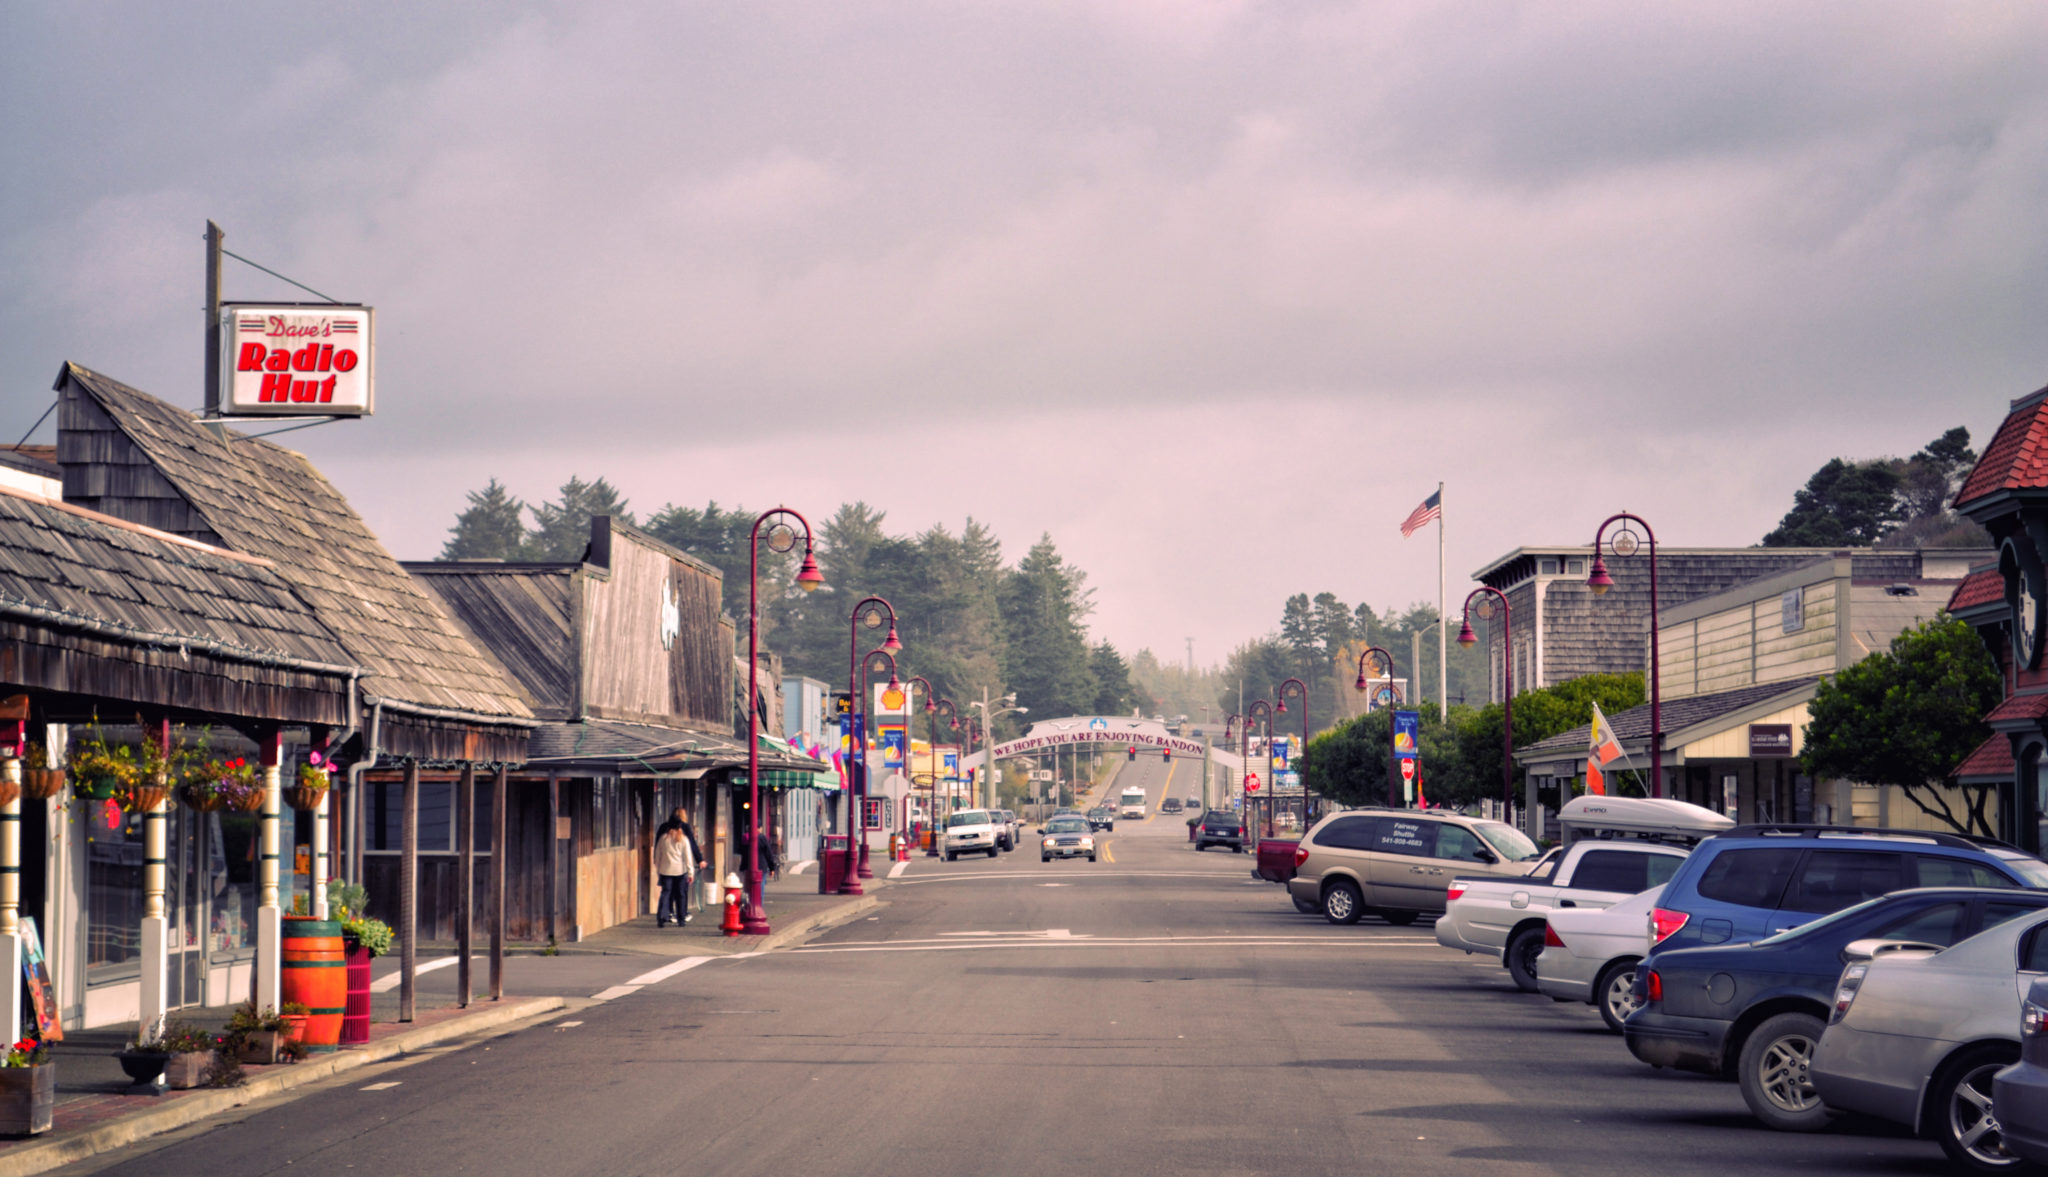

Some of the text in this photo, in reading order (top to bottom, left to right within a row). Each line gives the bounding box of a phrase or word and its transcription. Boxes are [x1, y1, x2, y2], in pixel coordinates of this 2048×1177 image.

[265, 316, 331, 337] Dave's
[237, 342, 358, 372] Radio
[258, 373, 337, 403] Hut
[993, 732, 1204, 757] WE HOPE YOU ARE ENJOYING BANDON
[1402, 763, 1414, 773] STOP
[1393, 830, 1415, 838] Shuttle
[1394, 822, 1419, 832] Fairway
